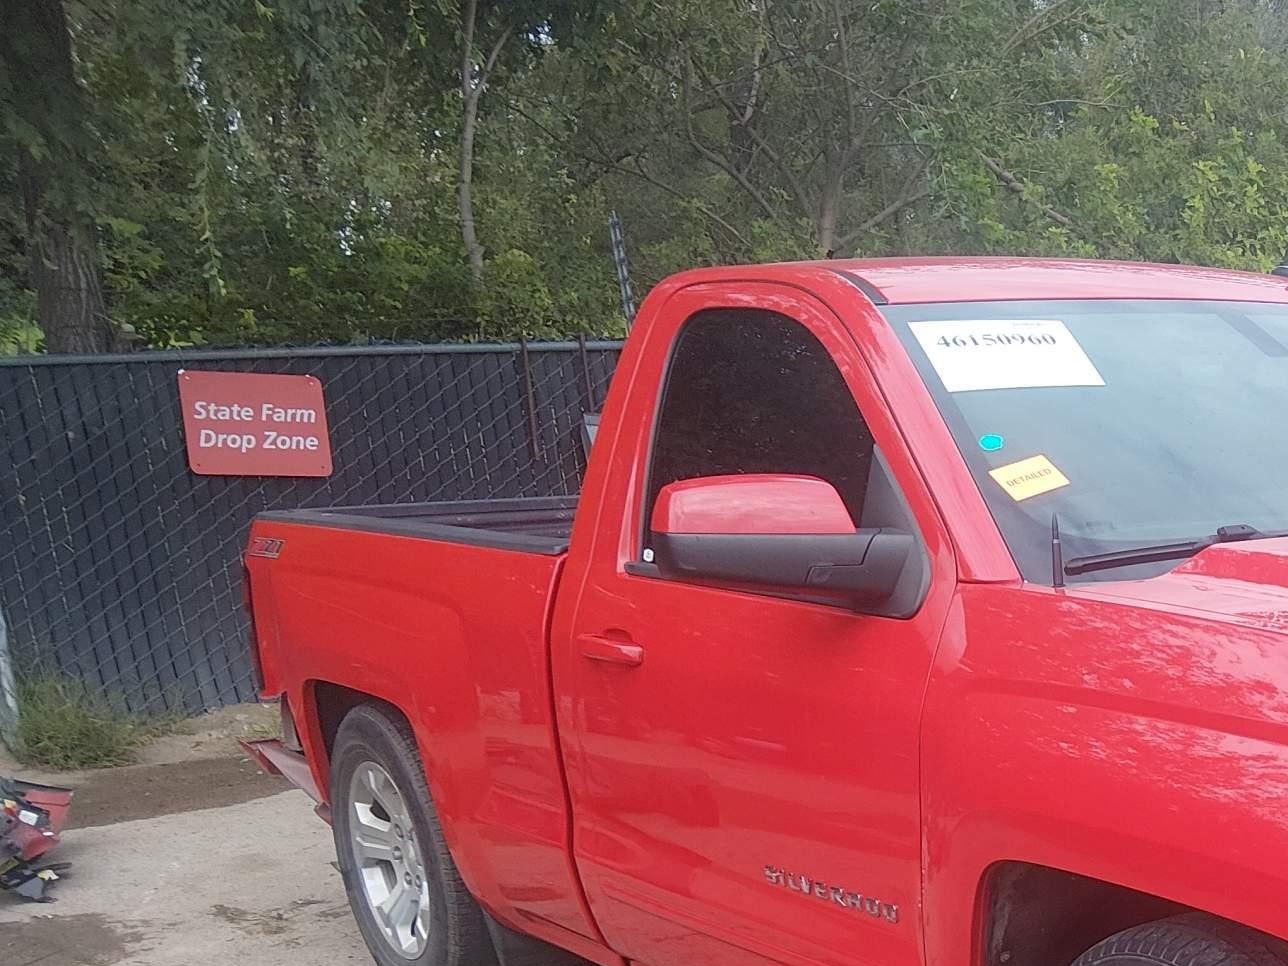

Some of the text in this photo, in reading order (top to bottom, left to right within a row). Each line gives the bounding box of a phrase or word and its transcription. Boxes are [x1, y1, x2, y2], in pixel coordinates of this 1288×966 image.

[936, 333, 1057, 348] 46150960
[193, 401, 316, 423] State Farm
[199, 429, 319, 453] Drop Zone
[1005, 468, 1053, 488] DETAILED
[763, 864, 899, 924] SILVERADO
